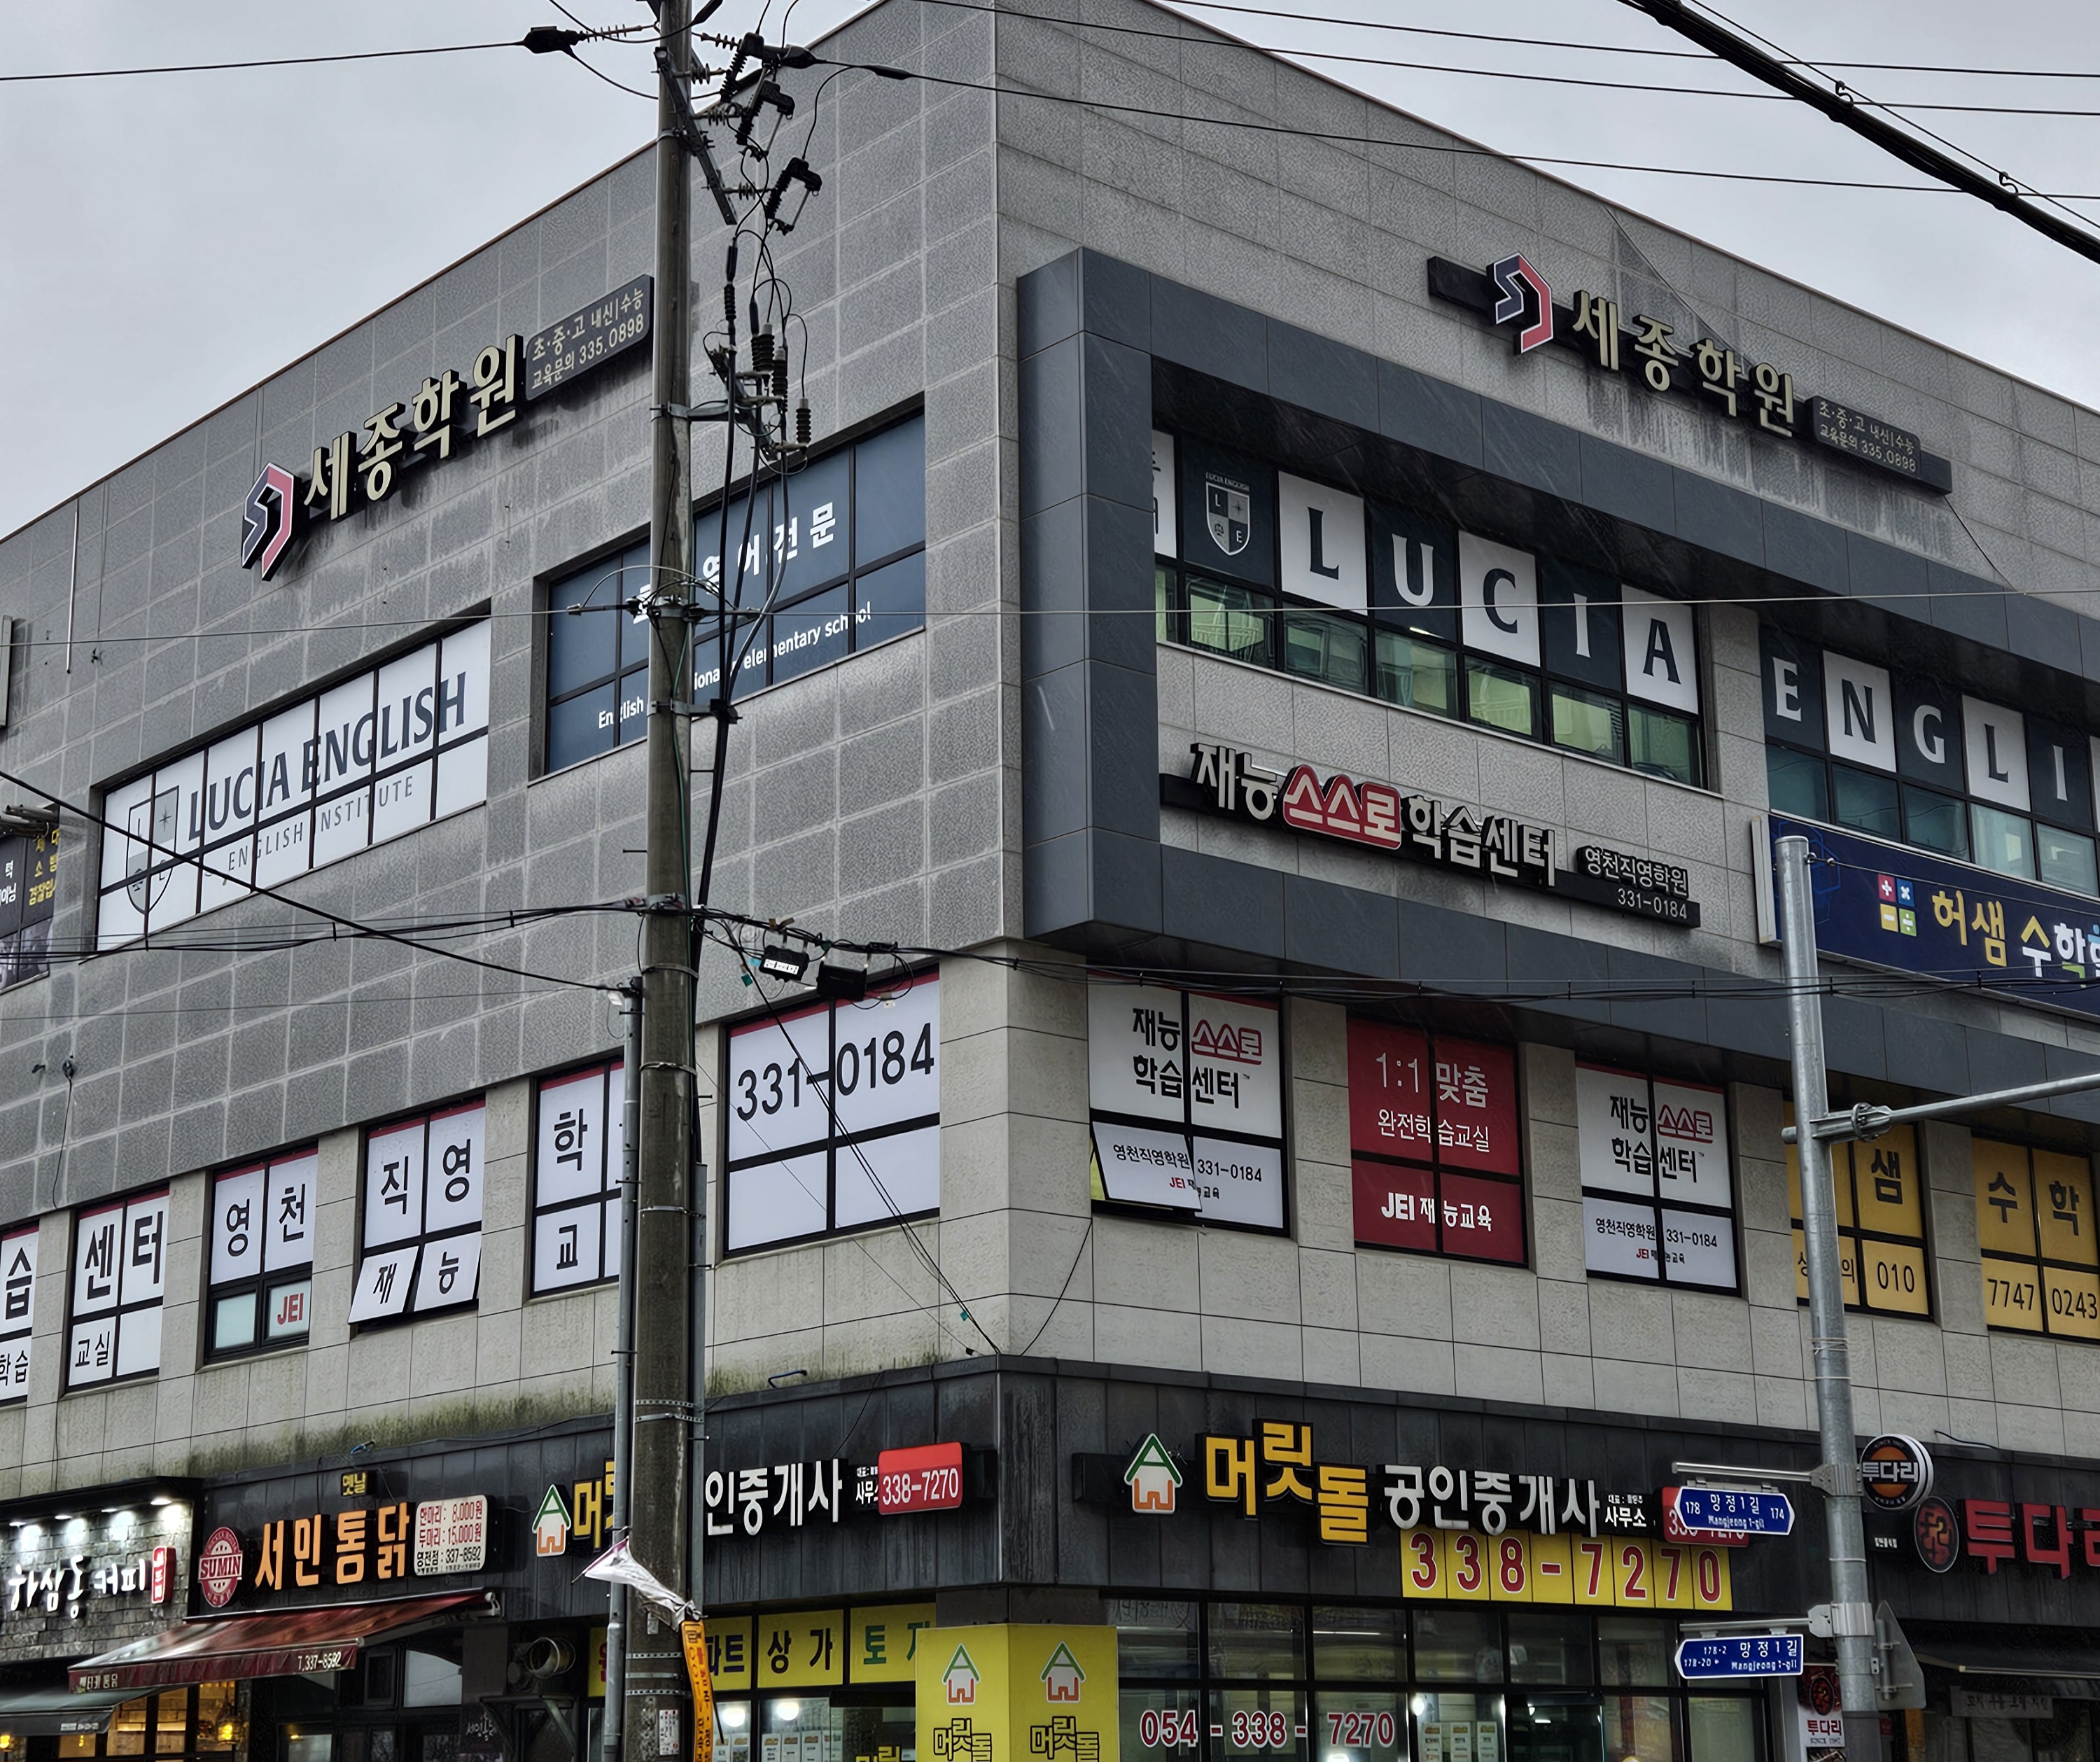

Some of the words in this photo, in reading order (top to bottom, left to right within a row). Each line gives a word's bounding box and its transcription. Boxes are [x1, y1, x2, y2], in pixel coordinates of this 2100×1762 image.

[532, 353, 575, 389] 교육문의
[578, 314, 645, 367] 335.0898
[1572, 289, 1794, 438] 세종학원
[304, 334, 519, 520] 세종학원
[825, 601, 872, 637] schol
[1308, 507, 1681, 685] LUCIA
[598, 697, 644, 729] Enlish
[1772, 657, 2068, 802] ENGLI
[188, 753, 290, 841] LUCIA
[301, 672, 467, 791] ENGLISH
[228, 821, 304, 872] ENGLISH
[321, 776, 413, 832] NSTIUTE
[1197, 743, 1278, 820] 재능
[1283, 772, 1400, 840] 스스로
[1408, 799, 1555, 887] 학습센터
[1583, 846, 1688, 896] 영천직영학원
[1617, 888, 1688, 921] 331-0184
[1932, 890, 2008, 967] 허샘
[1132, 1007, 1181, 1052] 재능
[1191, 1019, 1263, 1065] 스스로
[737, 1023, 935, 1121] 331-0184
[1134, 1054, 1240, 1109] 학습센터
[1376, 1052, 1420, 1093] 1:1
[1436, 1062, 1489, 1108] 맞춤
[1610, 1096, 1648, 1133] 재능
[1657, 1104, 1714, 1143] 스스로
[1113, 1144, 1190, 1170] 영천직영학원
[1197, 1159, 1262, 1182] 331-0184
[1170, 1177, 1186, 1189] JEI
[85, 1210, 164, 1300] 센터
[226, 1183, 306, 1257] 영천
[381, 1138, 471, 1215] 직영
[1382, 1192, 1415, 1221] JEI
[1420, 1197, 1492, 1232] 재능교육
[1596, 1218, 1656, 1240] 영천직영학원
[1667, 1229, 1717, 1247] 331-0184
[1636, 1248, 1649, 1259] JEI
[1877, 1261, 1915, 1293] 010
[373, 1251, 459, 1304] 재능
[1987, 1278, 2035, 1312] 7747
[2052, 1287, 2098, 1320] 0243
[277, 1292, 304, 1325] JEI
[75, 1331, 111, 1368] 교실
[343, 1472, 366, 1495] 옛날
[883, 1468, 959, 1505] 338-7270
[1205, 1422, 1368, 1543] 머릿돌
[1385, 1464, 1600, 1537] 공인중개사
[1863, 1462, 1919, 1483] 투다리
[705, 1459, 843, 1536] 인중개사
[1605, 1506, 1647, 1527] 사무소
[1686, 1502, 1701, 1515] 178
[1770, 1507, 1784, 1520] 174
[201, 1556, 241, 1578] SUMIN
[255, 1502, 410, 1590] 서민통닭
[1410, 1532, 1723, 1604] 338-7270
[93, 1558, 146, 1595] 커피
[706, 1635, 745, 1676] 파트
[767, 1628, 833, 1674] 상가
[1807, 1720, 1842, 1736] 투다리
